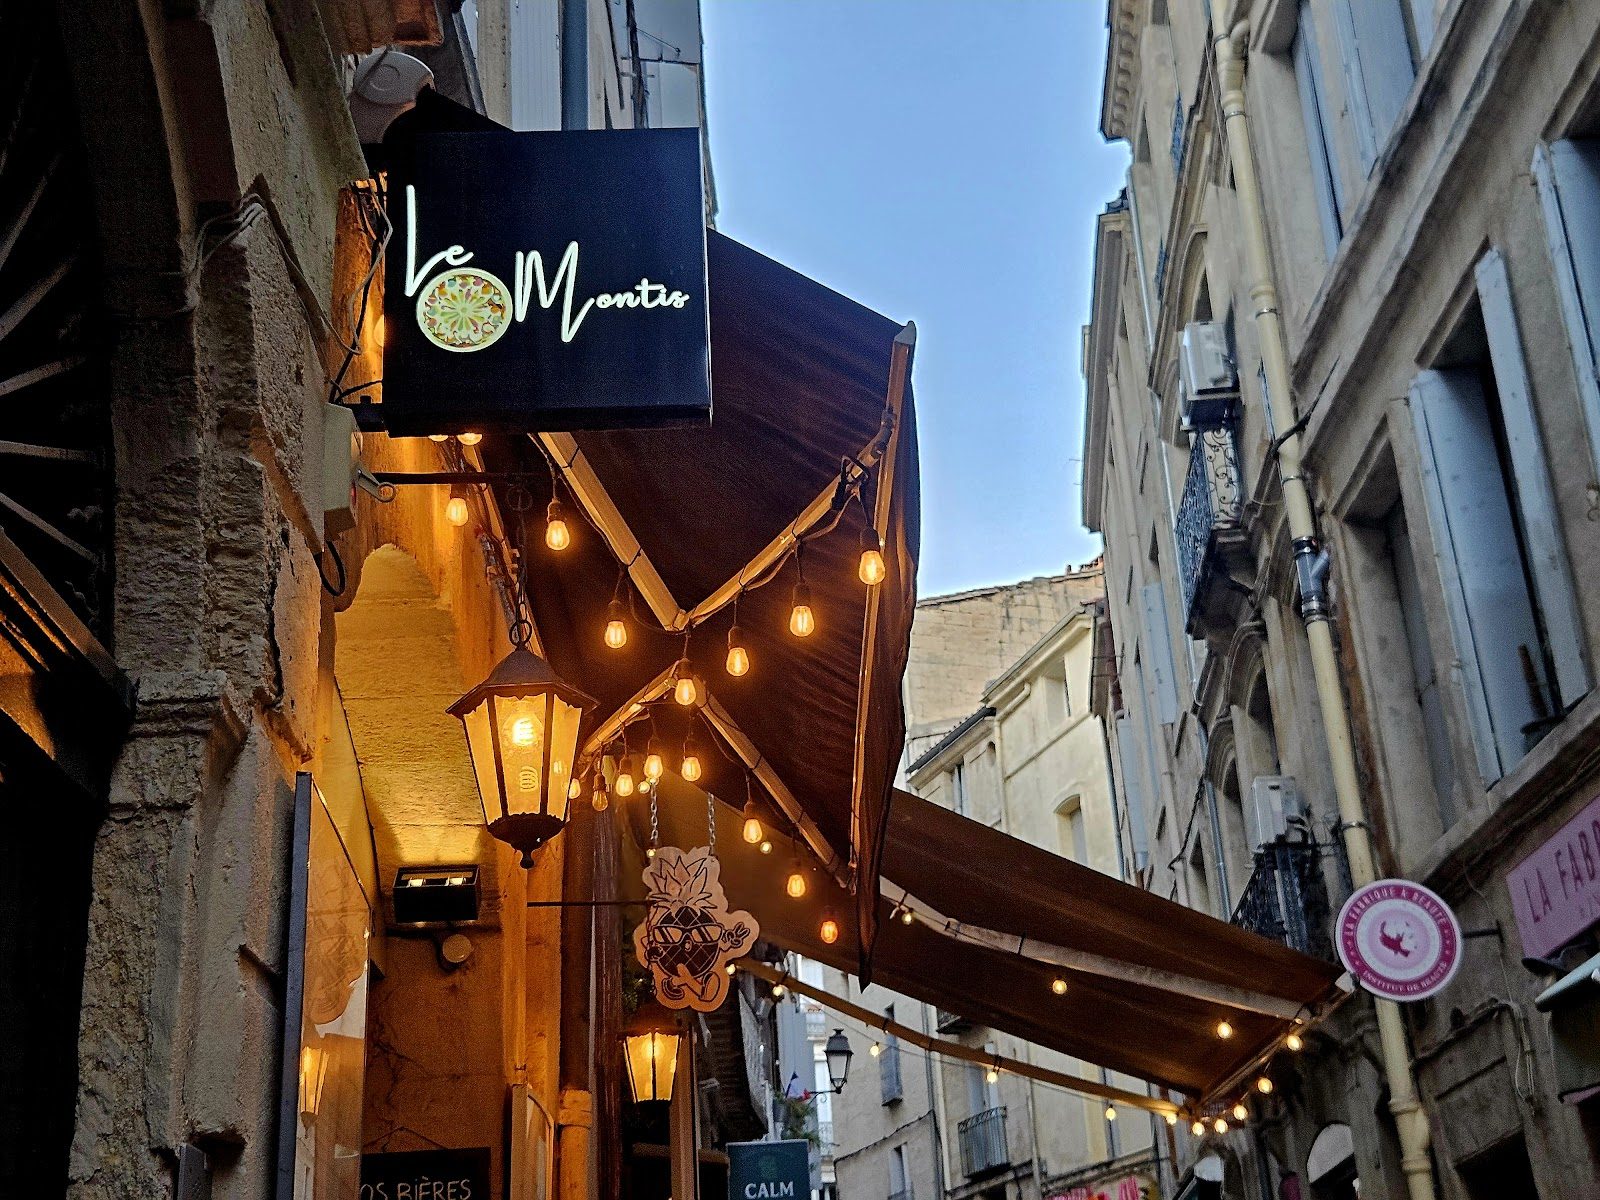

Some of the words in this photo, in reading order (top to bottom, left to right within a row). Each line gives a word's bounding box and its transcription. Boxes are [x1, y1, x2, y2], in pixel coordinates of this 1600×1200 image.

[404, 184, 474, 297] Le
[515, 240, 690, 343] Montis
[1348, 887, 1396, 920] FABRIQUE
[1523, 867, 1552, 923] LA
[744, 1181, 795, 1199] CALM
